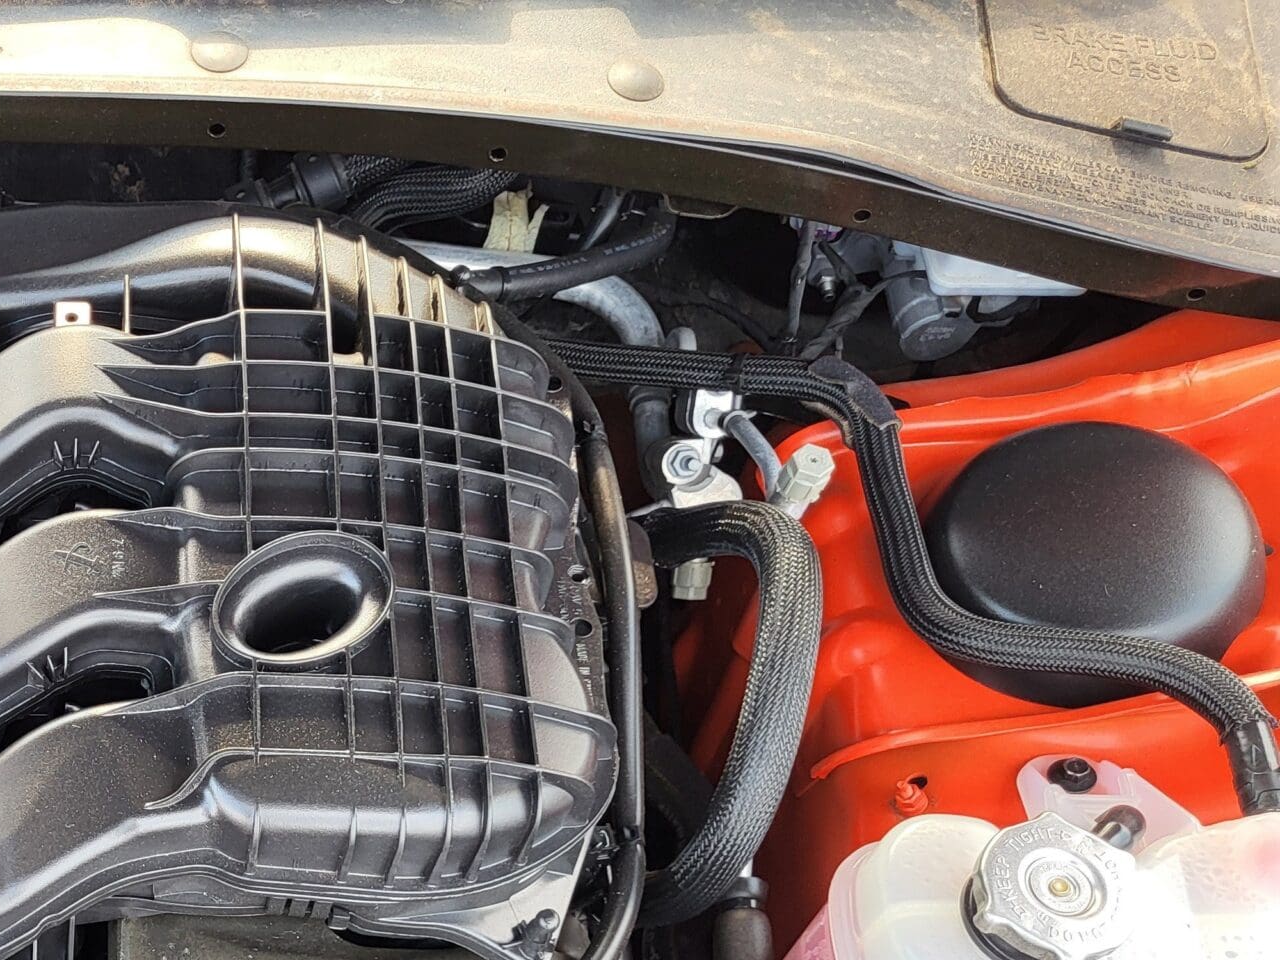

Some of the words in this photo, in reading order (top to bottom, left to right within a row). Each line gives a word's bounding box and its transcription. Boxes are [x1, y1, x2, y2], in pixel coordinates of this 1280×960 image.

[1030, 23, 1127, 53] BRAKE
[1135, 37, 1217, 61] FLUID
[1068, 52, 1181, 83] ACCESS
[1004, 826, 1057, 852] TIGHT
[994, 854, 1019, 903] KEEP
